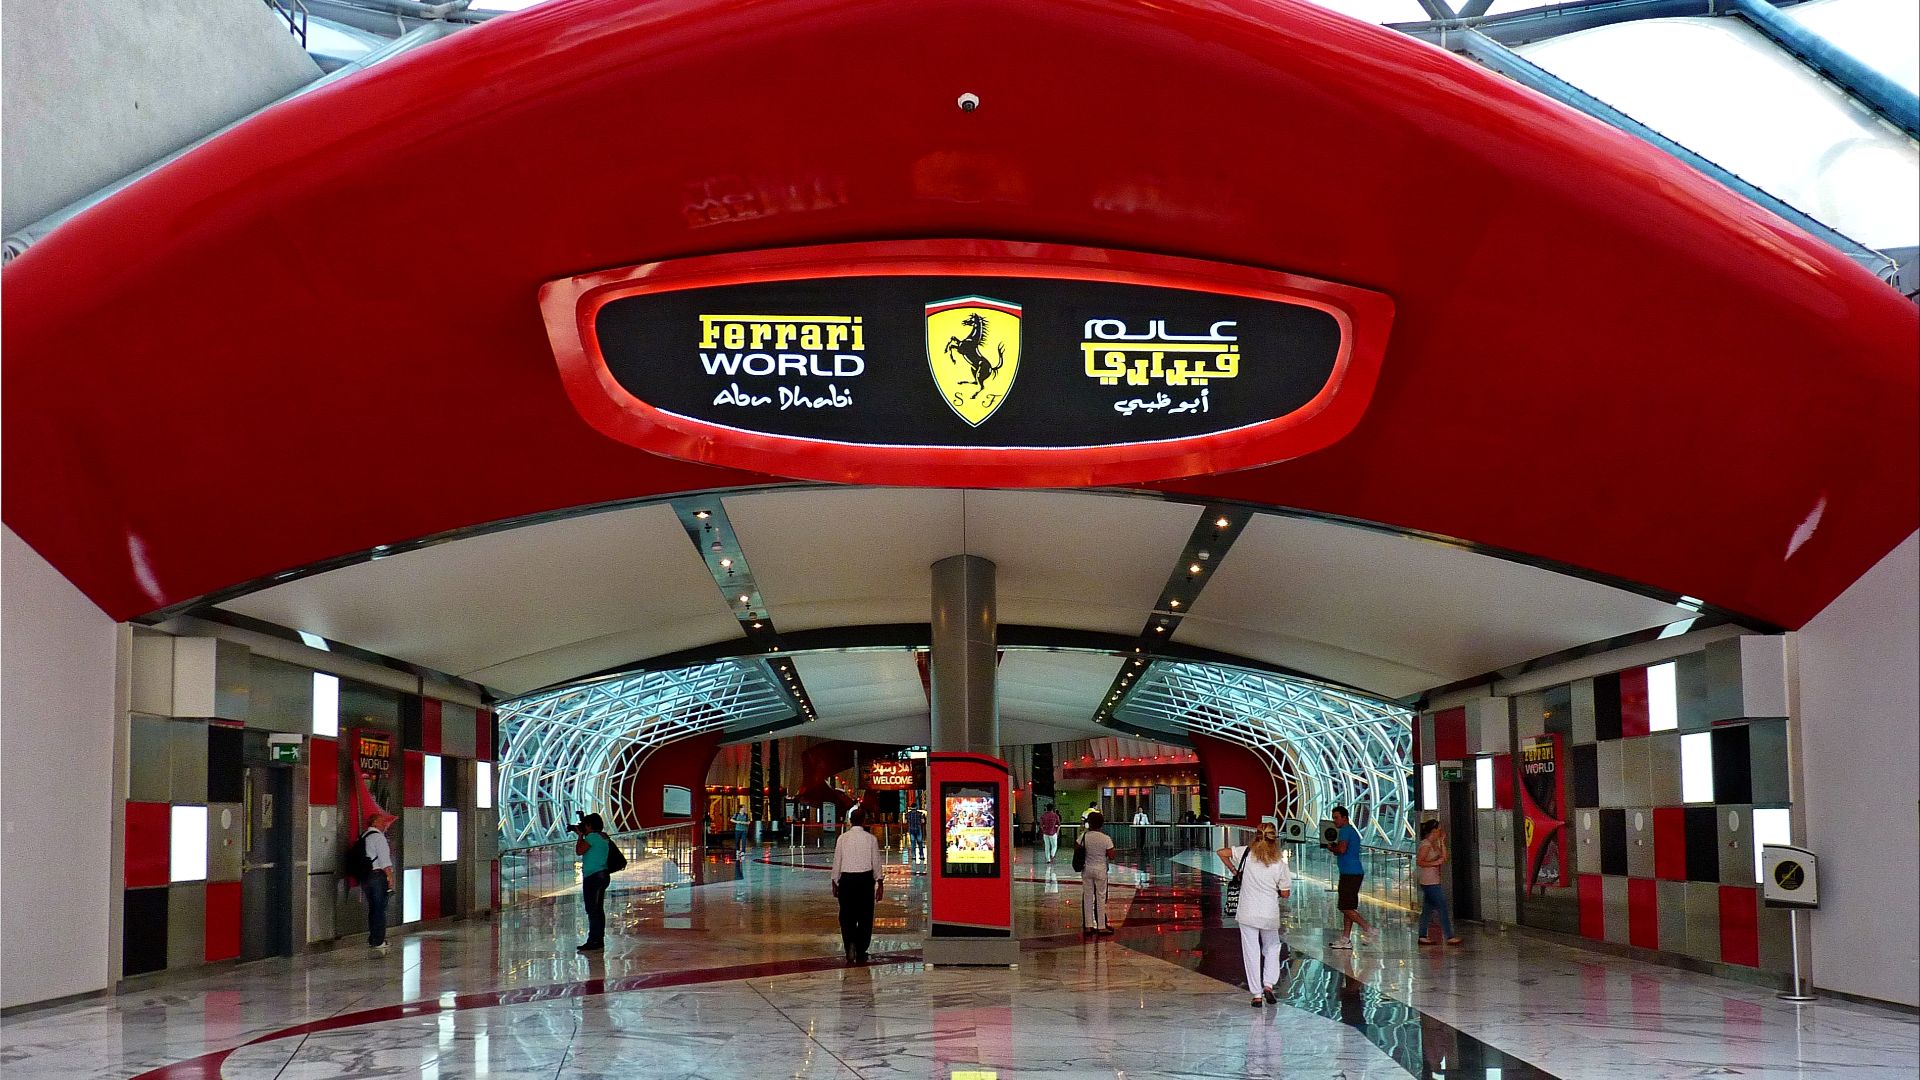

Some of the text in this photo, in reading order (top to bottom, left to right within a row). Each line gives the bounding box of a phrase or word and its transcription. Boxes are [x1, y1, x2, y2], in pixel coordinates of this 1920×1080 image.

[699, 315, 865, 350] Ferrari
[1085, 319, 1237, 341] عالم
[699, 353, 865, 377] WORLD
[1081, 343, 1240, 385] فيراري
[713, 383, 853, 411] Abu Dhabi
[360, 757, 390, 770] WORLD
[1525, 761, 1555, 774] WORLD
[872, 776, 913, 785] WELCOME
